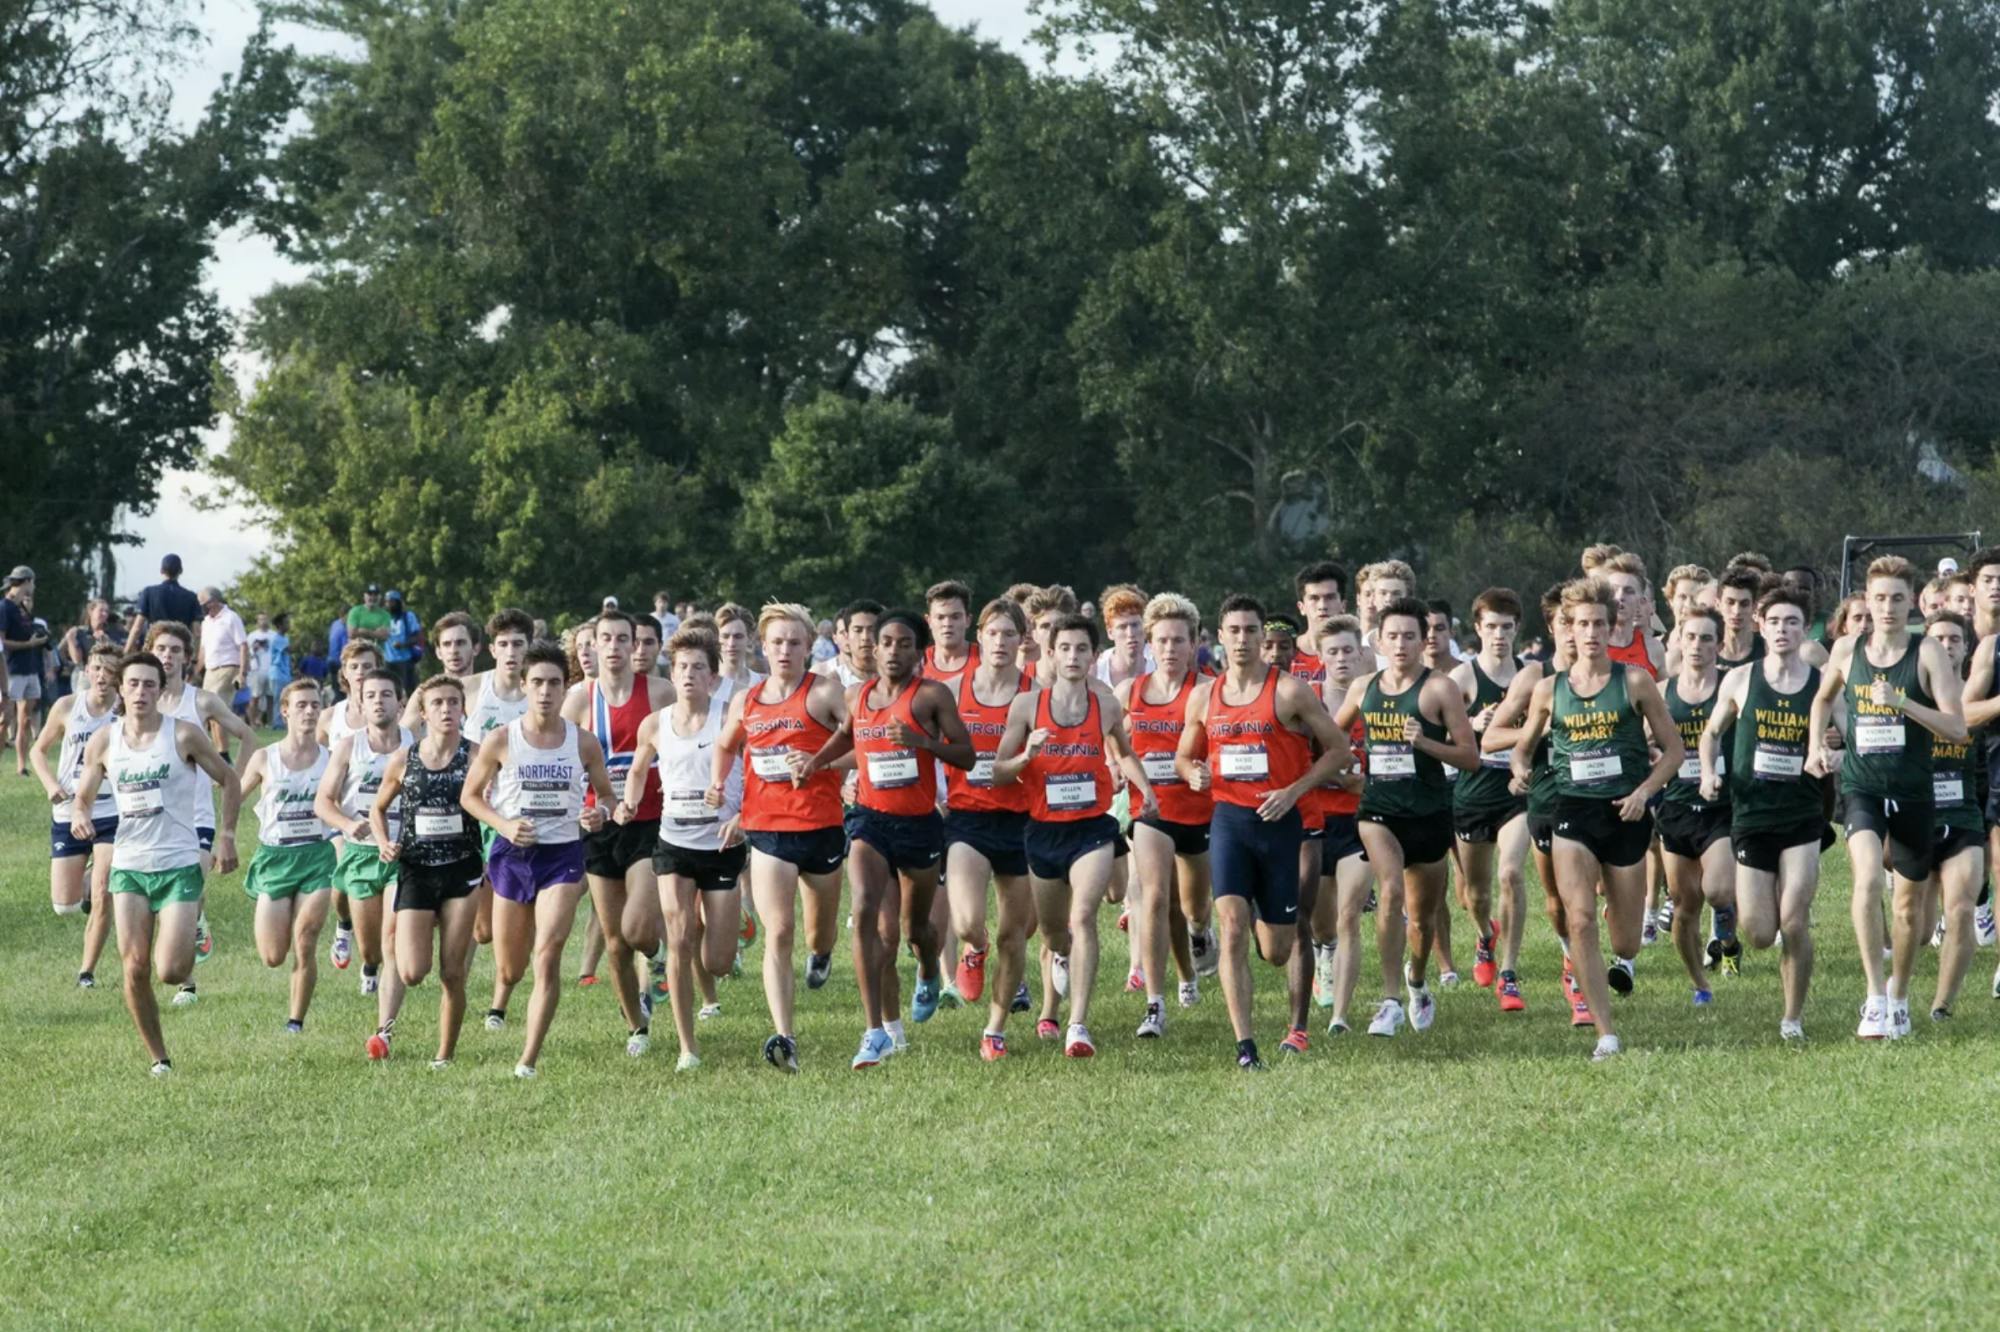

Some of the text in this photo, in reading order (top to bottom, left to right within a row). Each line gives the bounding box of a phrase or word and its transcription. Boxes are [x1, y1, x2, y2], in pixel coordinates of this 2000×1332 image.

[1563, 711, 1619, 728] WILLIAM
[1755, 708, 1808, 727] WILLIAM
[1212, 722, 1274, 737] VIRGINIA
[518, 764, 573, 780] NORTHEAST
